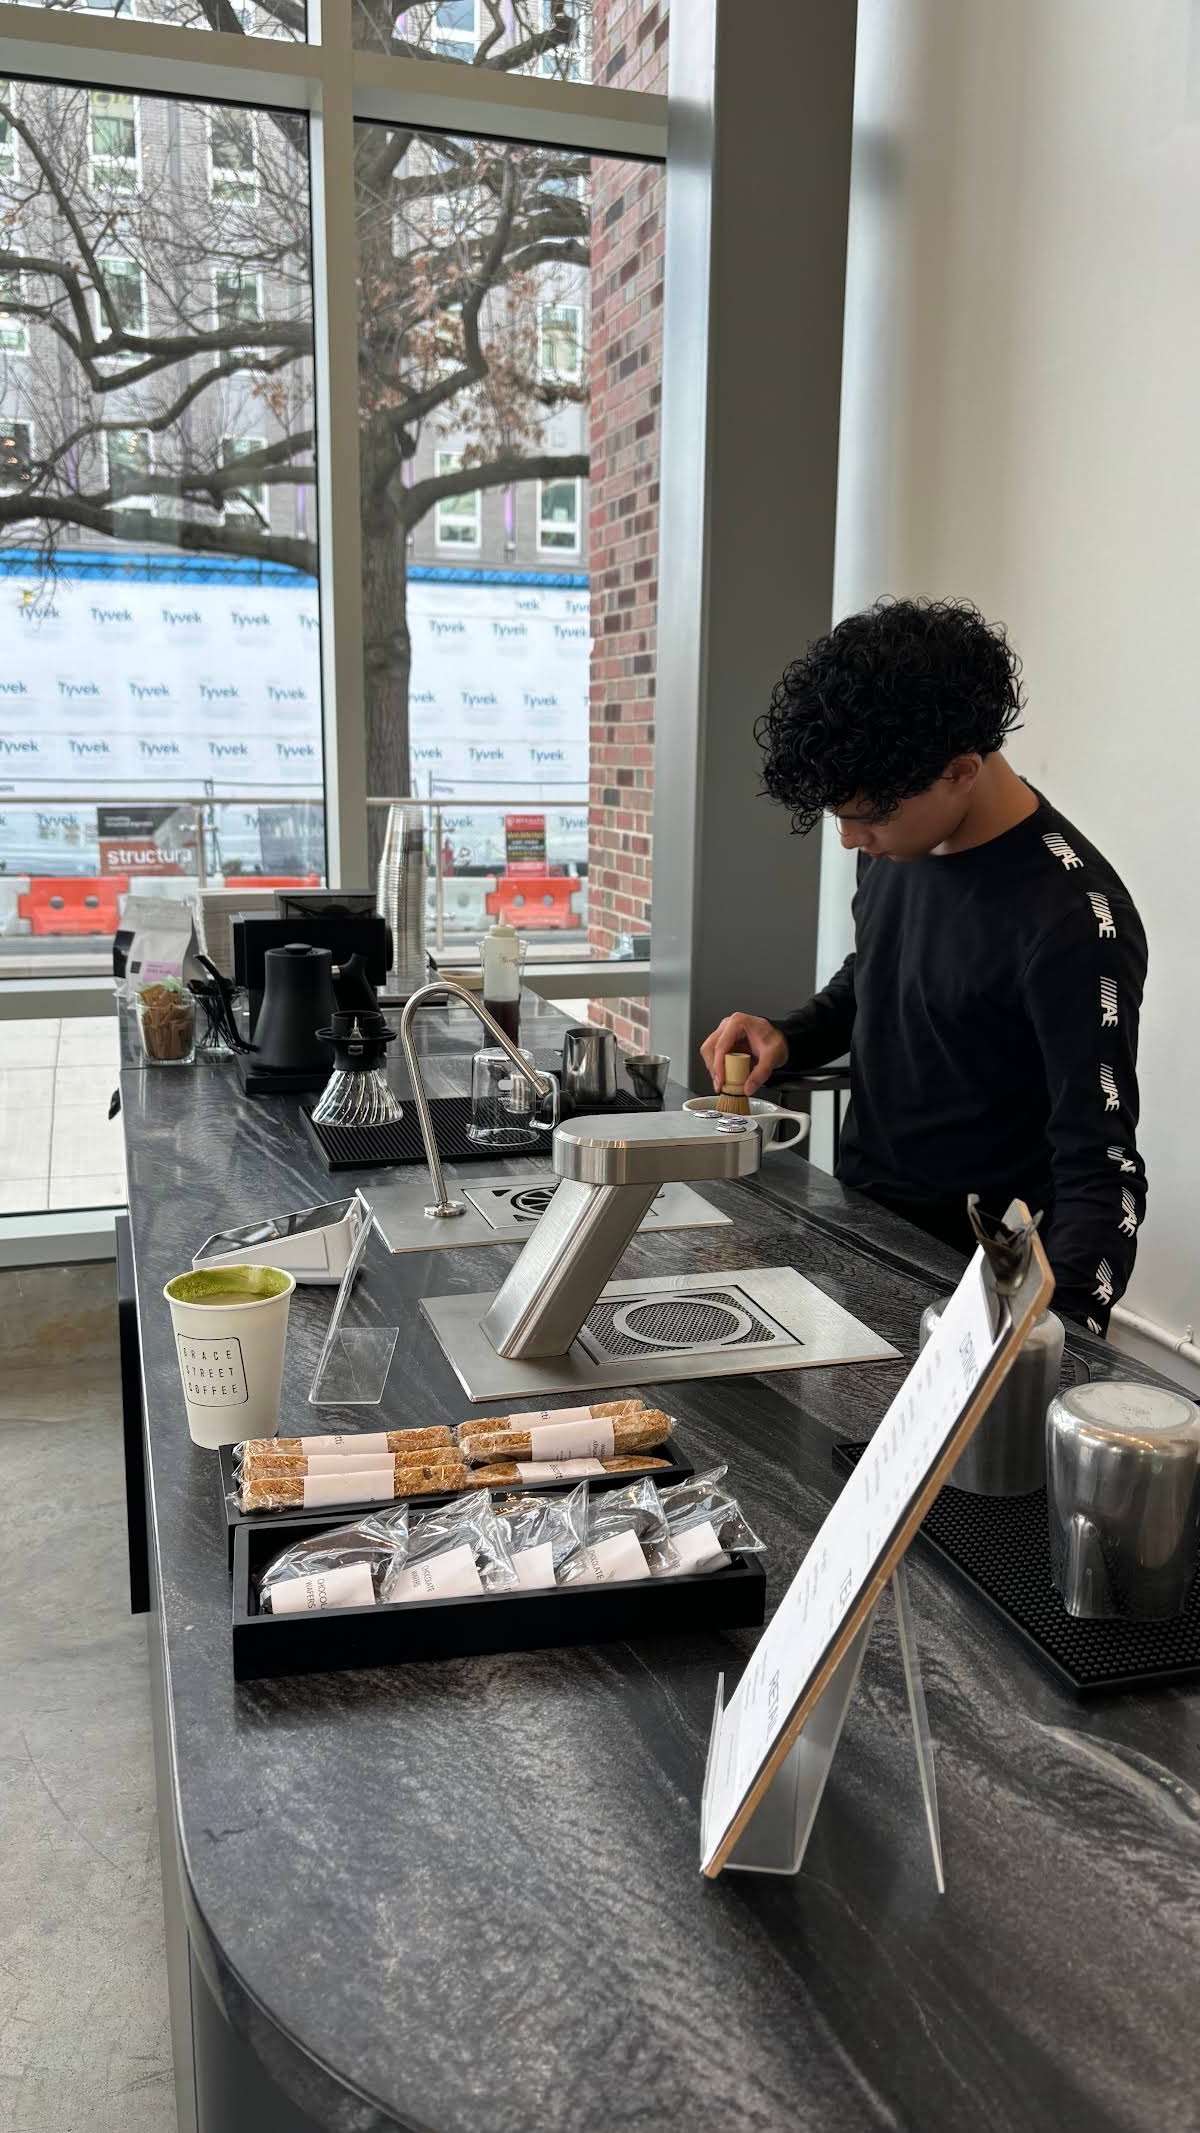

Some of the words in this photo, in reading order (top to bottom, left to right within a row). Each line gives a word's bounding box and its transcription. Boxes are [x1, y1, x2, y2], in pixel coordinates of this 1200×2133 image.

[19, 606, 59, 621] Tyvek
[91, 607, 133, 623] Tyvek
[162, 609, 201, 626] Tyvek
[231, 611, 270, 628] Tyvek
[429, 620, 466, 636] Tyvek
[492, 622, 528, 637] Tyvek
[554, 625, 587, 639] Tyvek
[58, 681, 100, 698] Tyvek
[129, 682, 169, 699] Tyvek
[200, 683, 239, 700] Tyvek
[267, 686, 306, 702] Tyvek
[462, 691, 498, 707] Tyvek
[523, 693, 557, 708] Tyvek
[68, 739, 110, 756] Tyvek
[139, 740, 179, 757] Tyvek
[208, 742, 248, 758] Tyvek
[275, 743, 314, 759] Tyvek
[410, 747, 443, 762] yvek
[469, 747, 504, 762] Tyvek
[530, 748, 564, 762] Tyvek
[36, 812, 77, 826] Tyvek
[443, 815, 473, 828] yvek
[185, 1365, 234, 1379] STREET
[188, 1382, 238, 1395] COFFEE
[305, 1580, 316, 1609] WAFERS
[317, 1578, 328, 1610] CHOCOL
[765, 1669, 780, 1744] RETAIL
